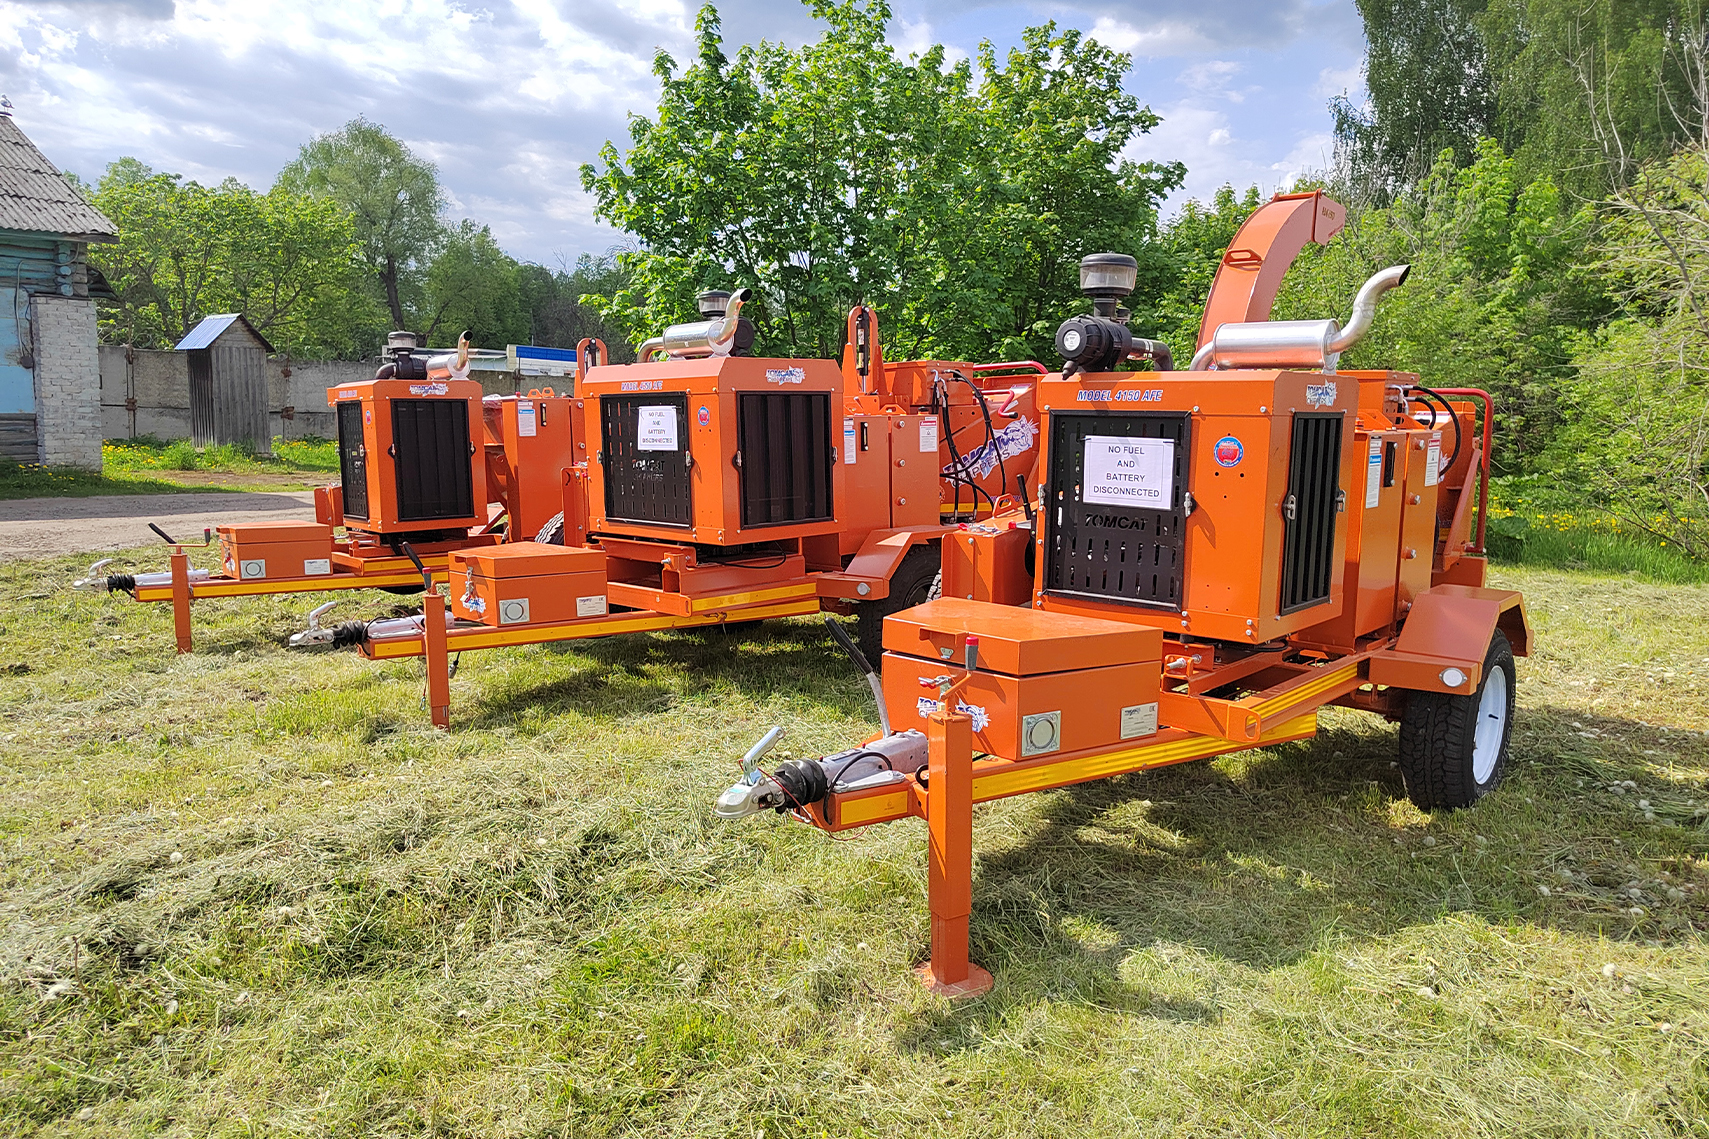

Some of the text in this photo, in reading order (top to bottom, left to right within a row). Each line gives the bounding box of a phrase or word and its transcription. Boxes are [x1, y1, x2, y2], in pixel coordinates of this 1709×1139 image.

[1077, 389, 1163, 401] MODEL 4150 AFE
[1123, 446, 1145, 455] FUEL
[1116, 460, 1135, 468] AND
[1106, 473, 1146, 482] BATTERY
[1093, 485, 1160, 497] DISCONNECTED
[1085, 513, 1149, 531] TOMCAT
